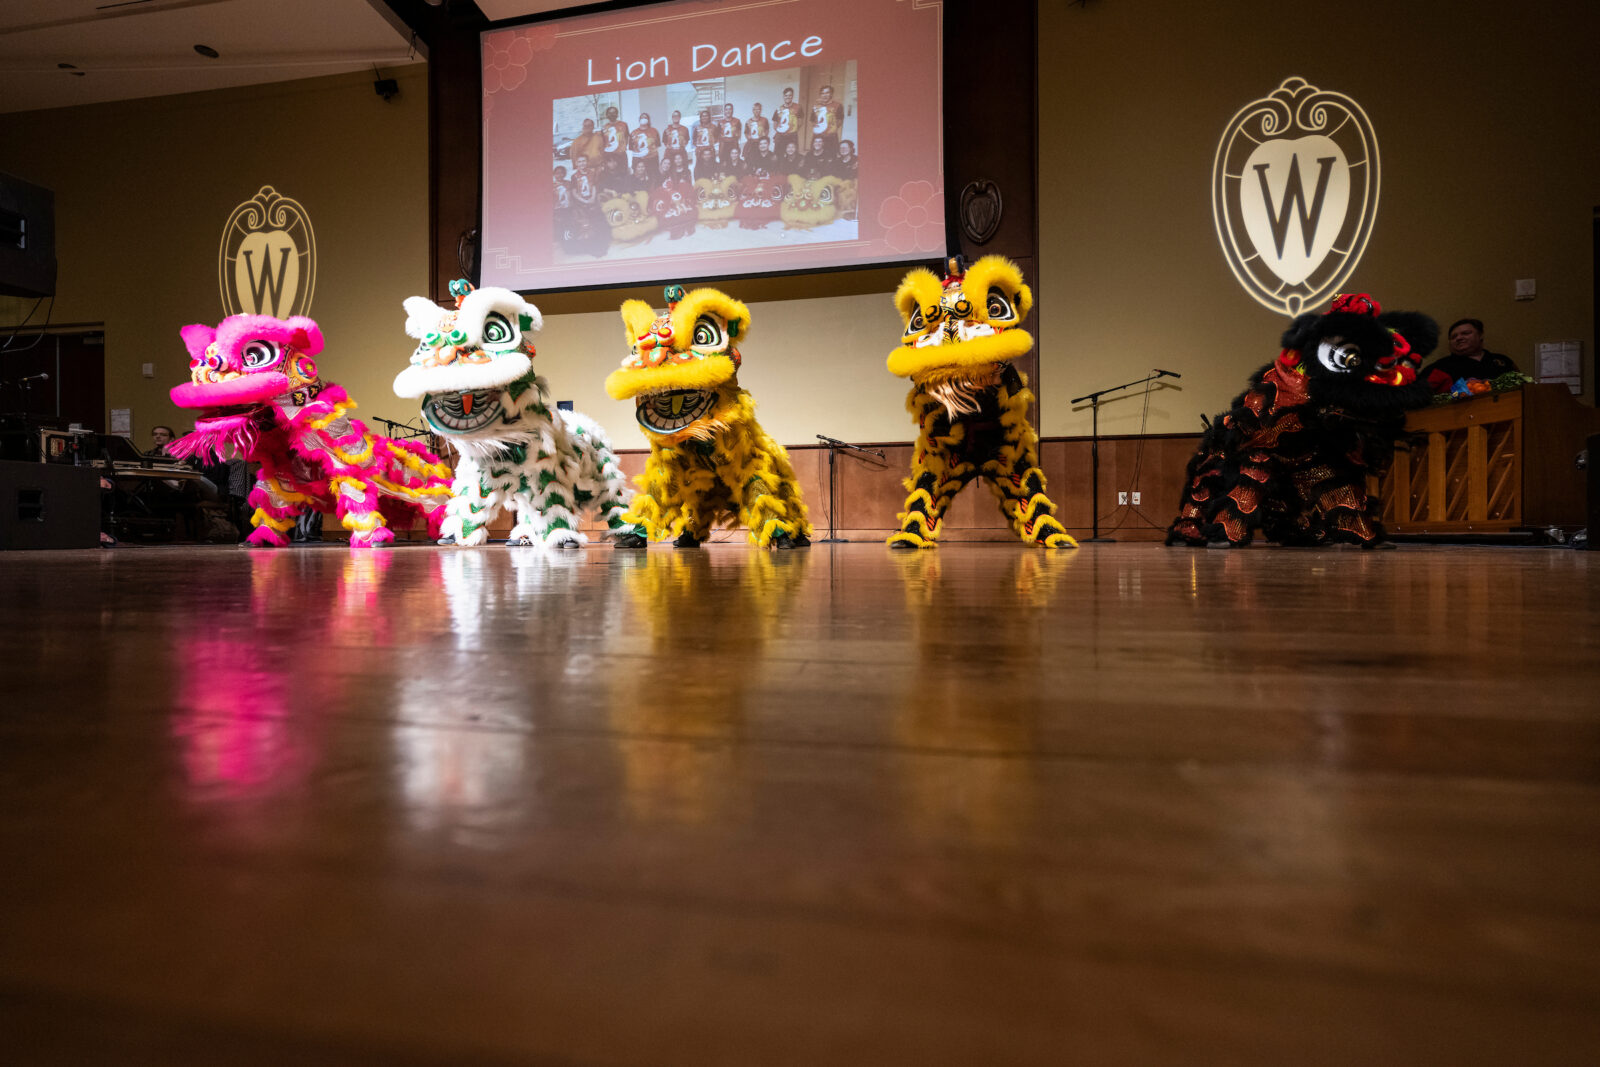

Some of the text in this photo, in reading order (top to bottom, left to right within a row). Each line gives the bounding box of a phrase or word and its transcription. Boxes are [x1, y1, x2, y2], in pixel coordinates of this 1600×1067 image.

[587, 35, 823, 86] Lion Dance
[1253, 153, 1336, 260] W
[243, 243, 291, 318] W
